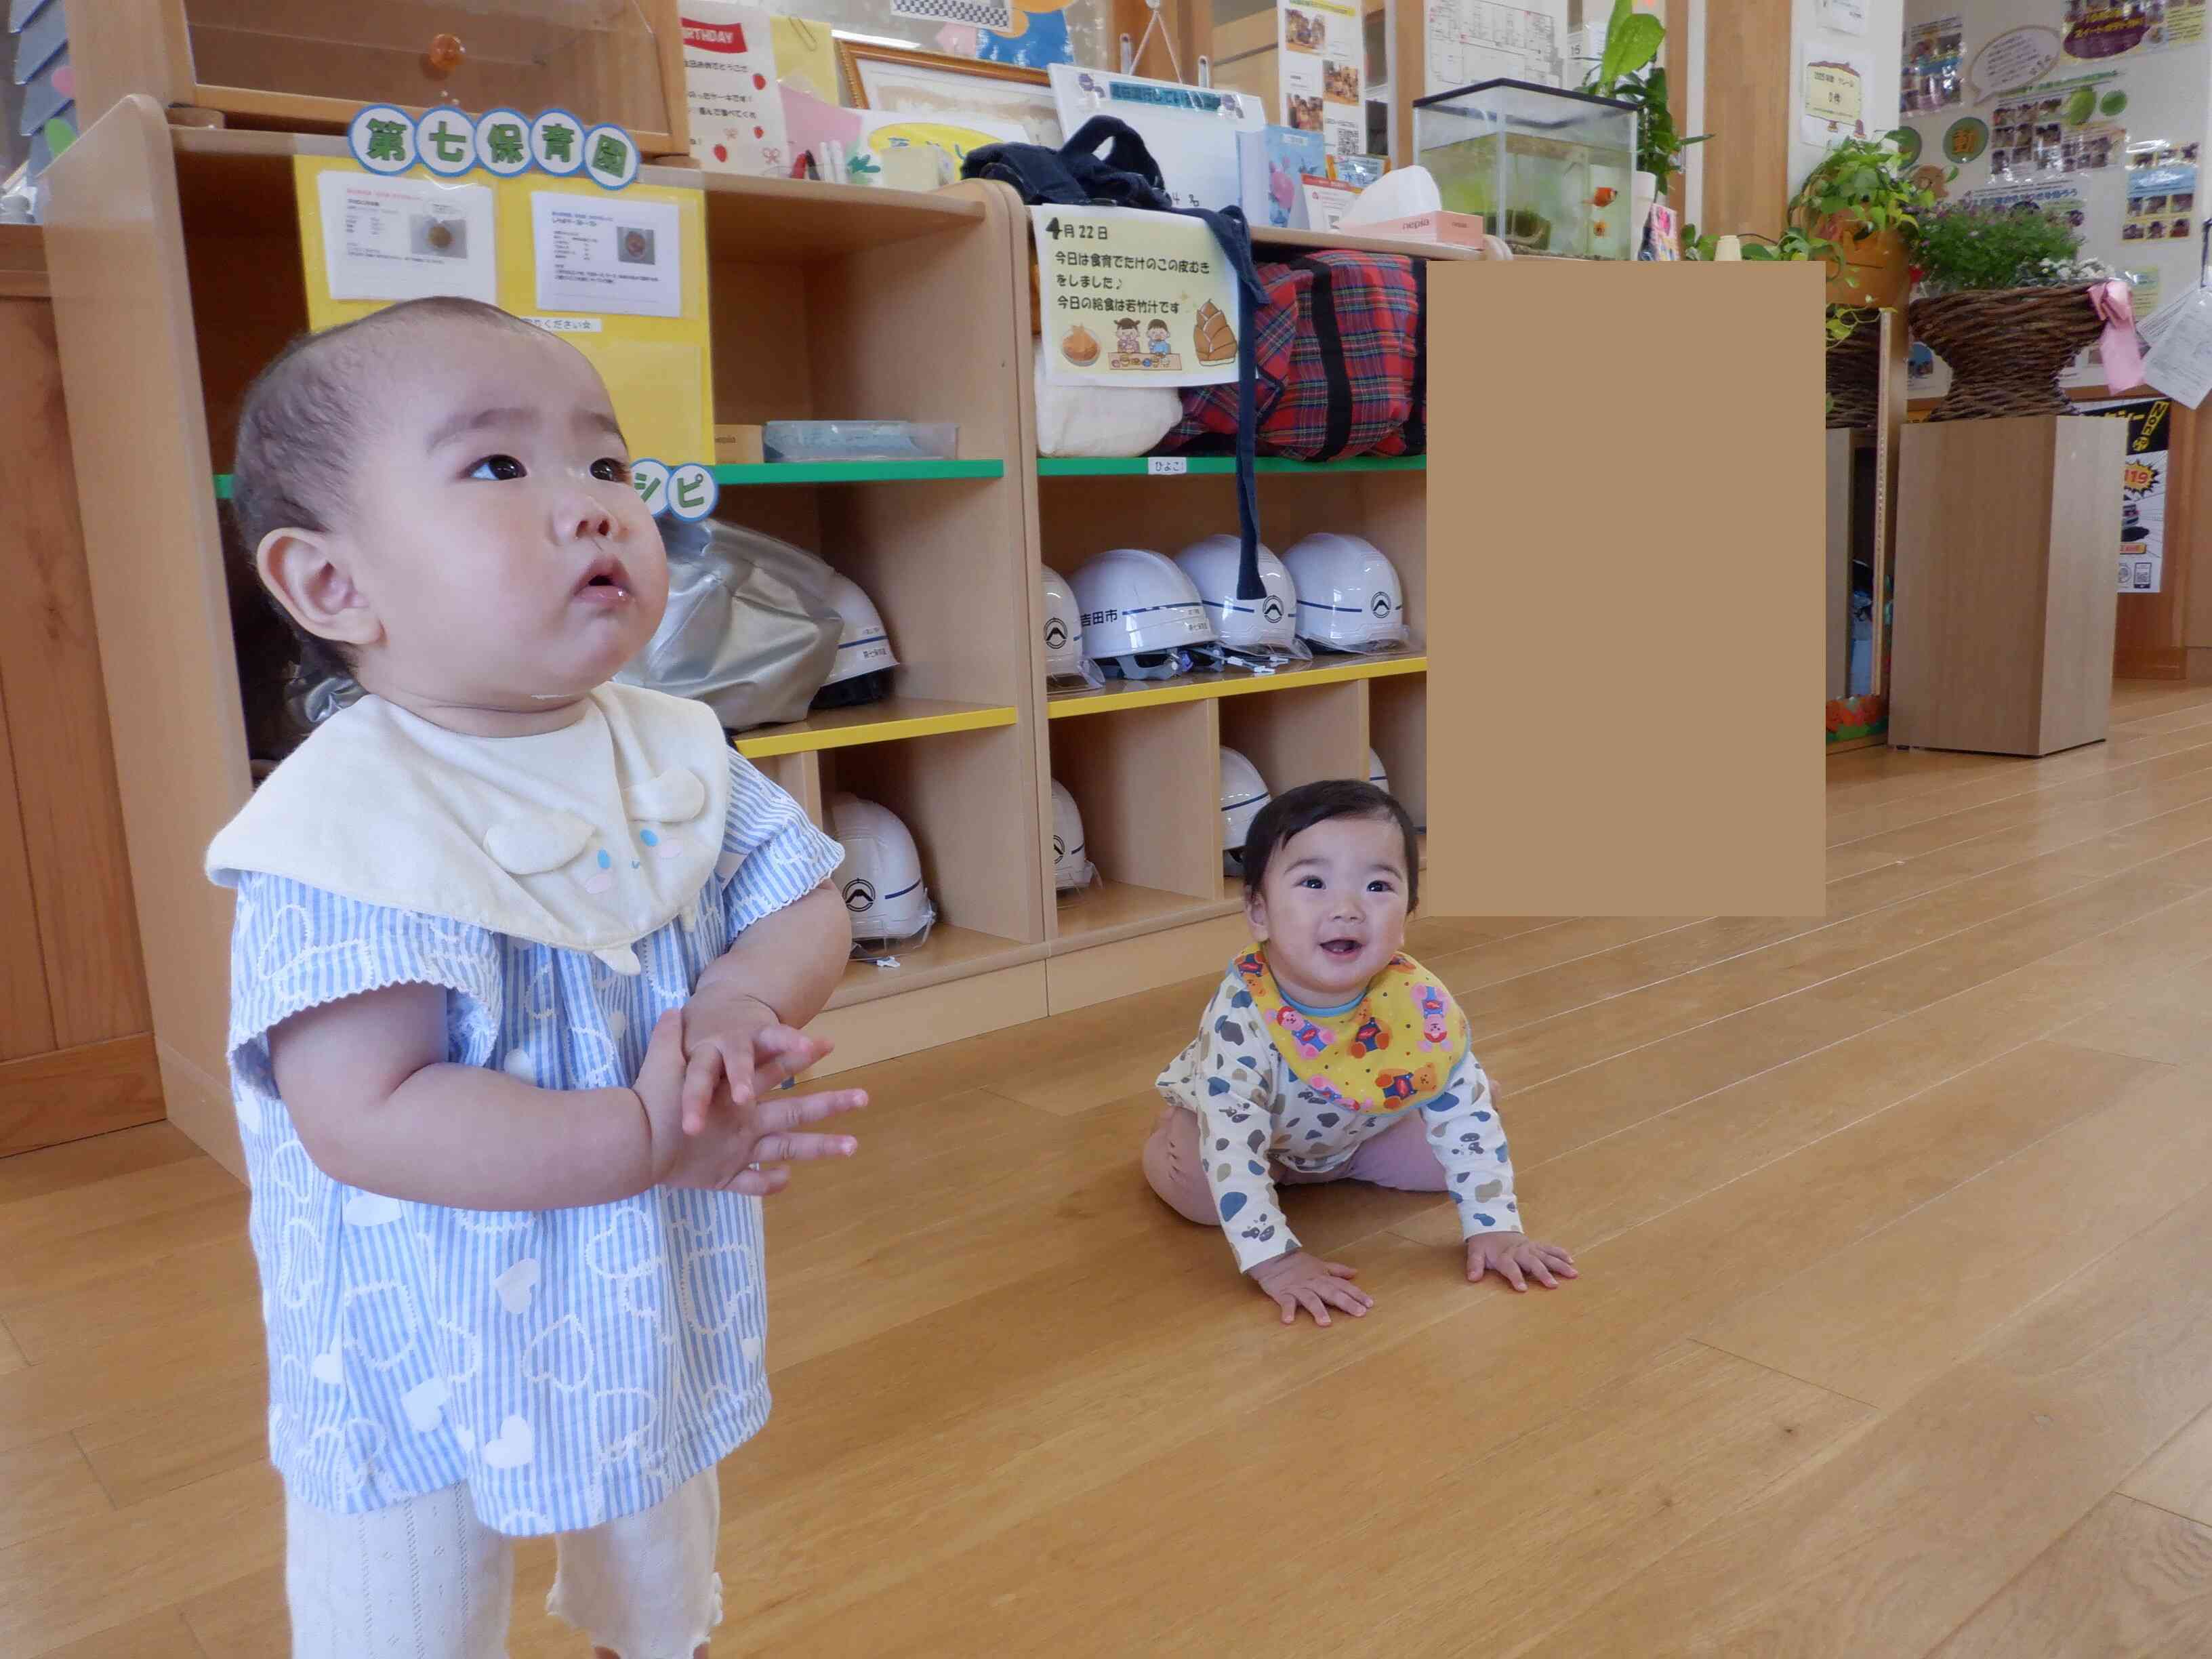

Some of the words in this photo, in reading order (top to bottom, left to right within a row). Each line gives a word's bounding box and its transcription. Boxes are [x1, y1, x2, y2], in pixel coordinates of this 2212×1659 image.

[365, 118, 628, 178] 第七保育園
[1054, 250, 1210, 274] 今日は食育でたけのこの皮むき
[1057, 295, 1181, 314] 今日の給食は若竹汁です
[1155, 461, 1179, 472] ひよこ
[634, 472, 705, 508] シピ
[1080, 609, 1118, 627] 吉田市
